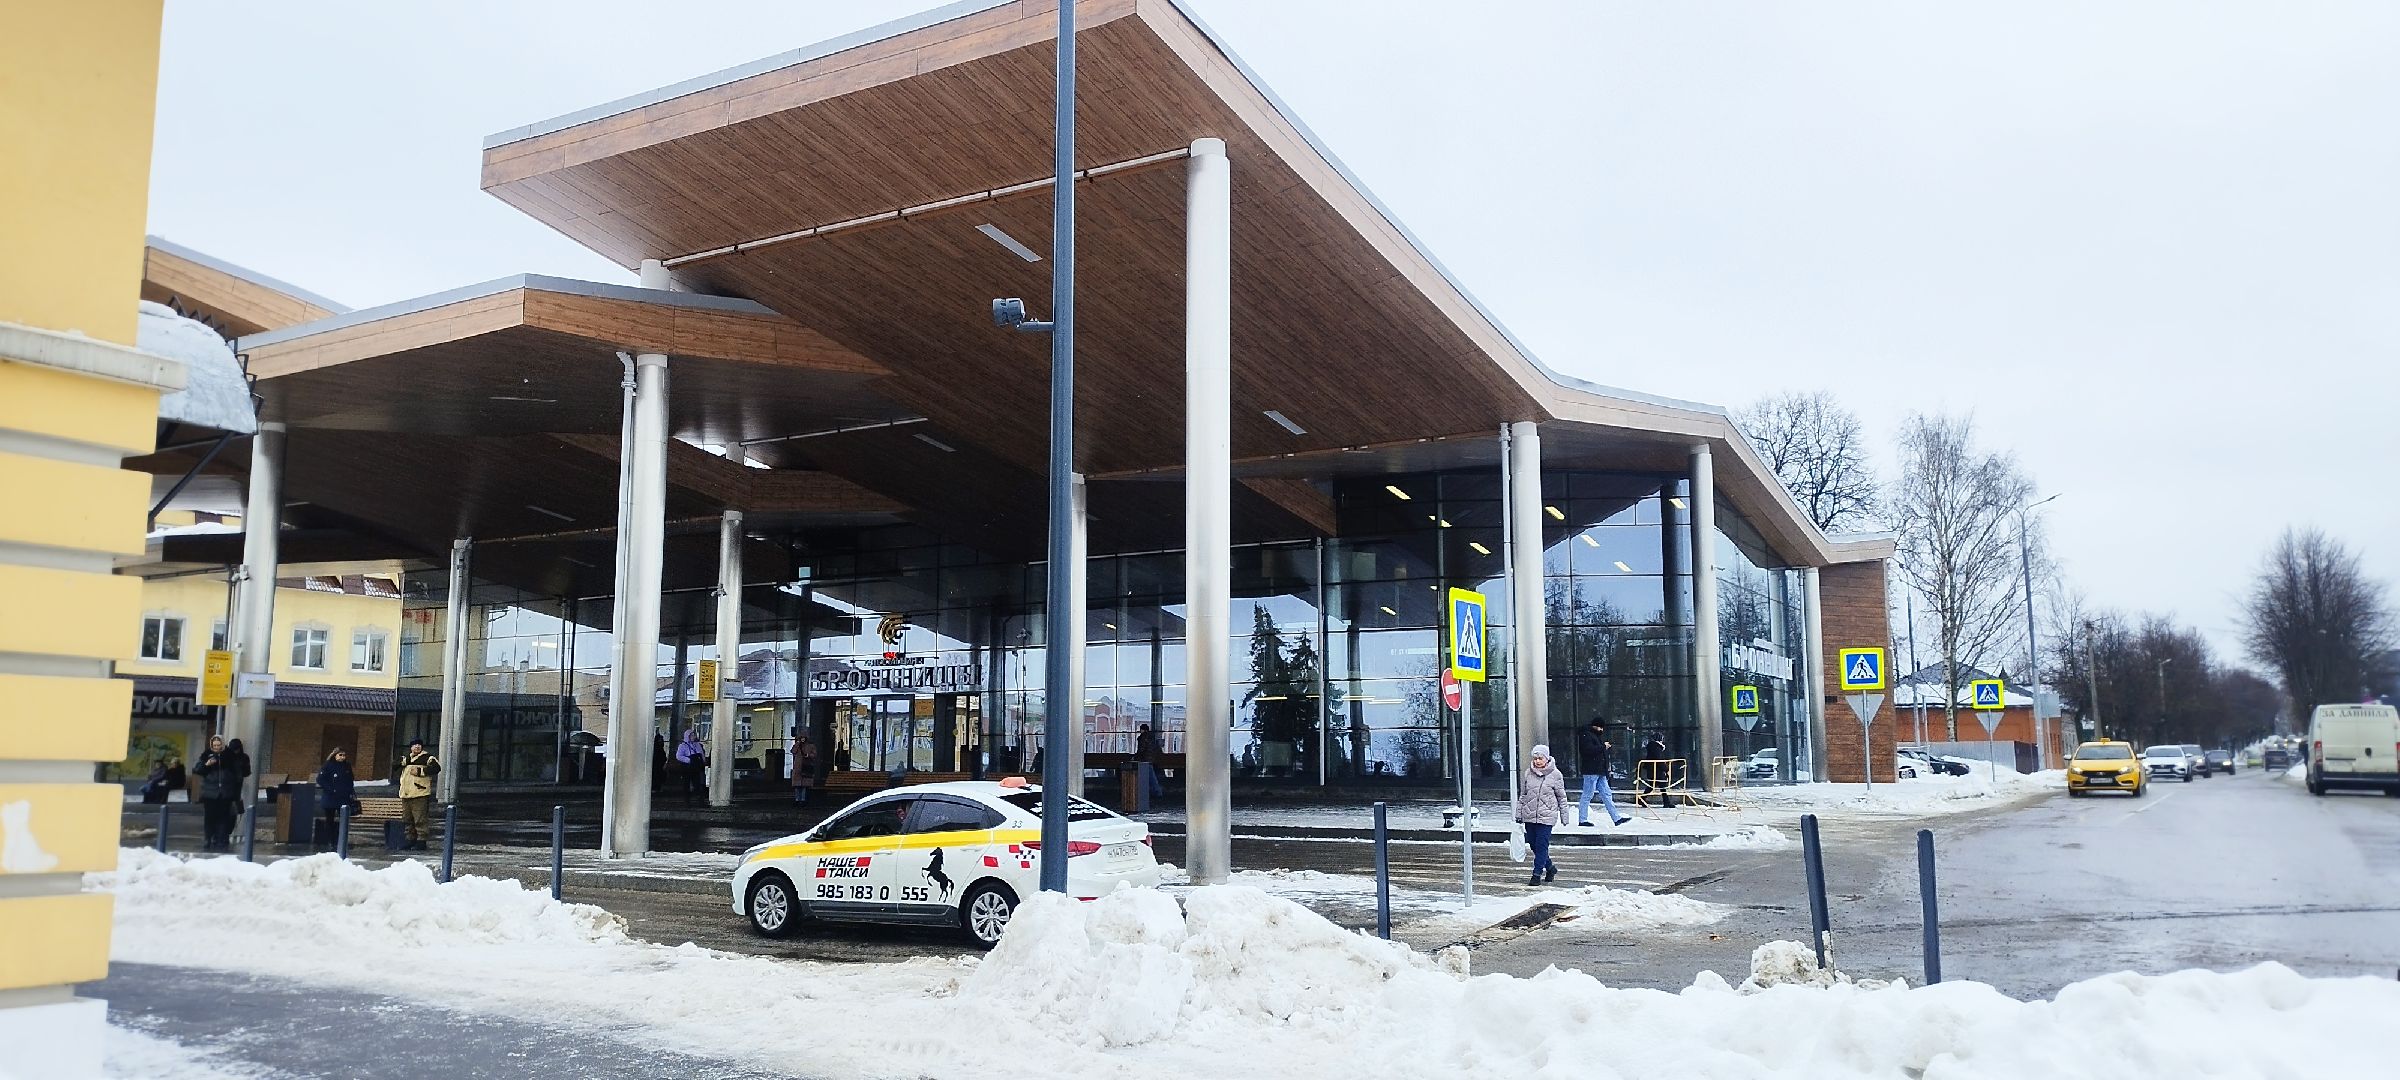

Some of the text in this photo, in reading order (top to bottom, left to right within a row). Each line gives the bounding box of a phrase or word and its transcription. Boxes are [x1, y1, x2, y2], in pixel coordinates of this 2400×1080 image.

[810, 664, 977, 691] БРОННИЦЫ
[2322, 709, 2335, 718] ЗА
[817, 857, 857, 867] НАШЕ
[828, 867, 869, 878] ТАКСИ
[816, 884, 929, 902] 985 183 0 555
